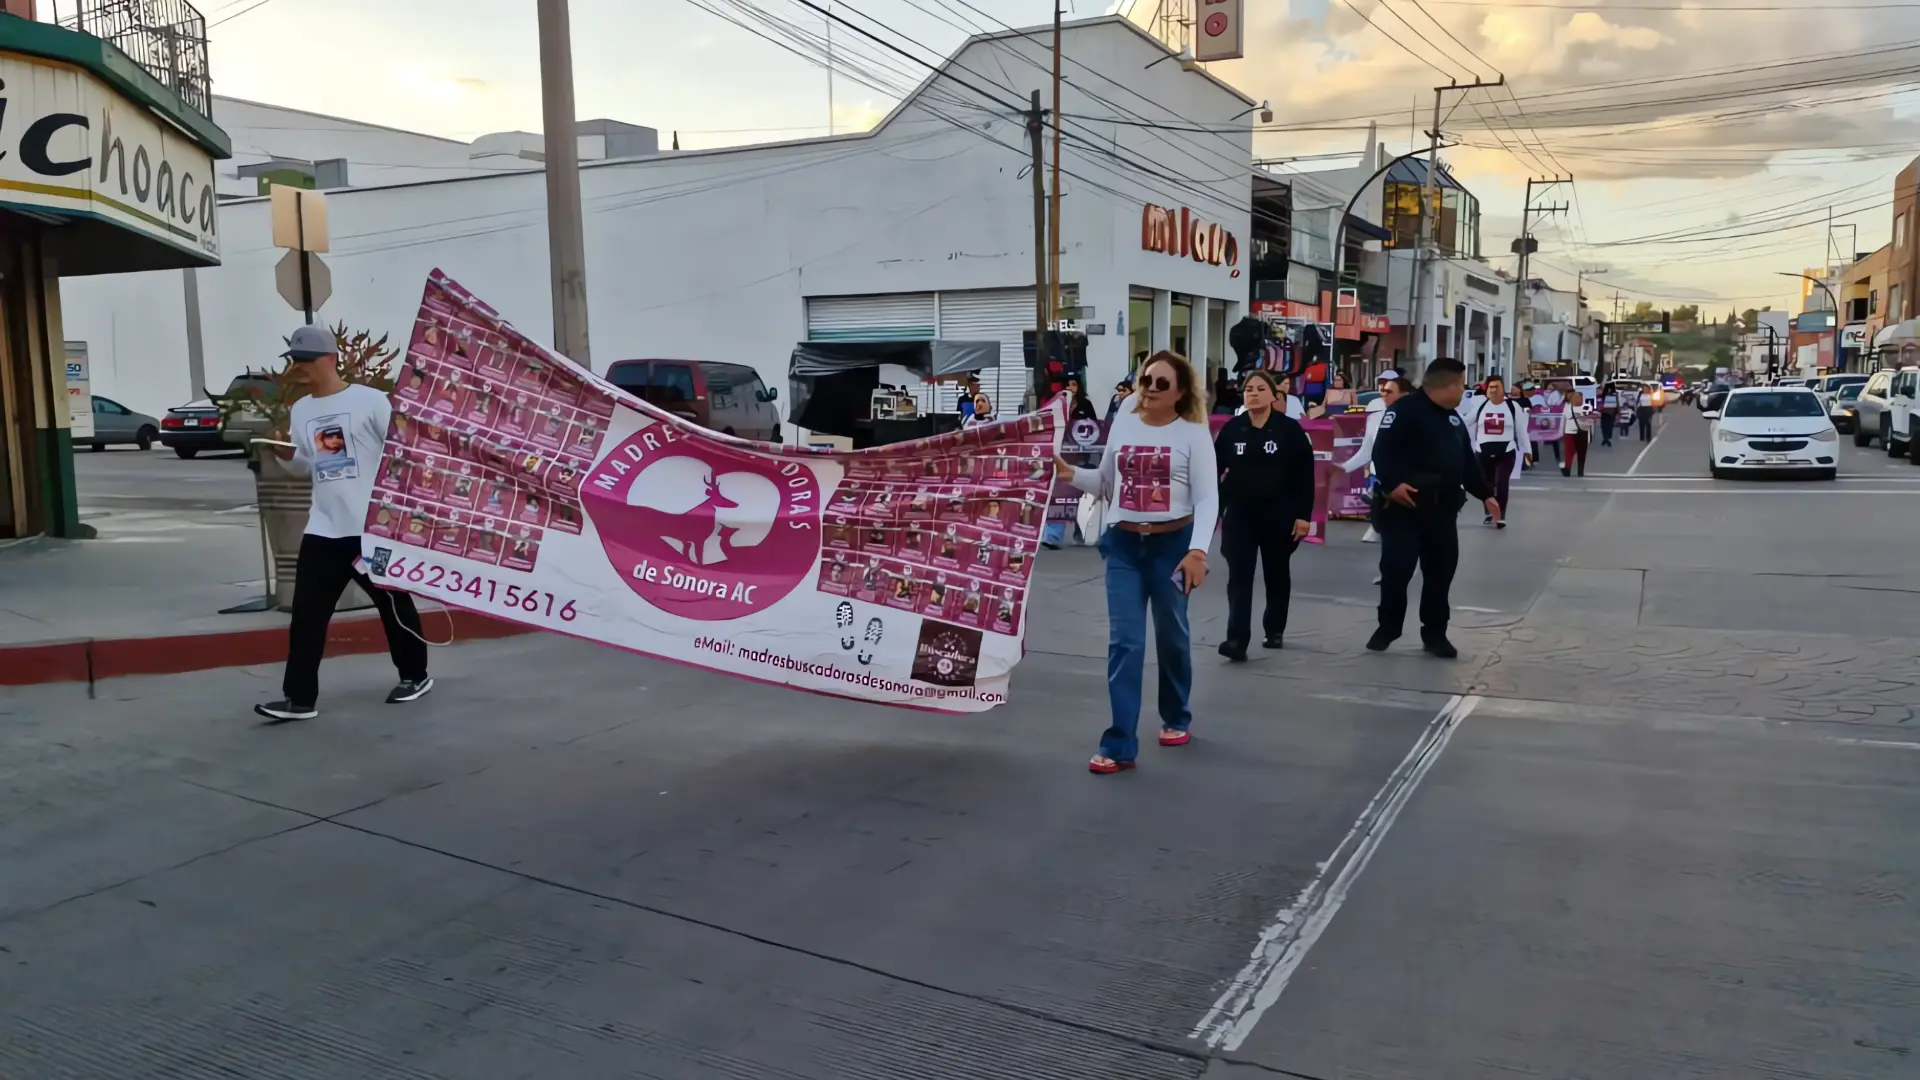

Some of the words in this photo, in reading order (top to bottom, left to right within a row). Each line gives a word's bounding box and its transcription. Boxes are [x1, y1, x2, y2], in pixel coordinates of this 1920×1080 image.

[593, 424, 688, 491] MADRE
[387, 557, 577, 622] 6623415616
[632, 560, 657, 582] de
[660, 566, 728, 599] Sonora
[731, 585, 757, 605] AC
